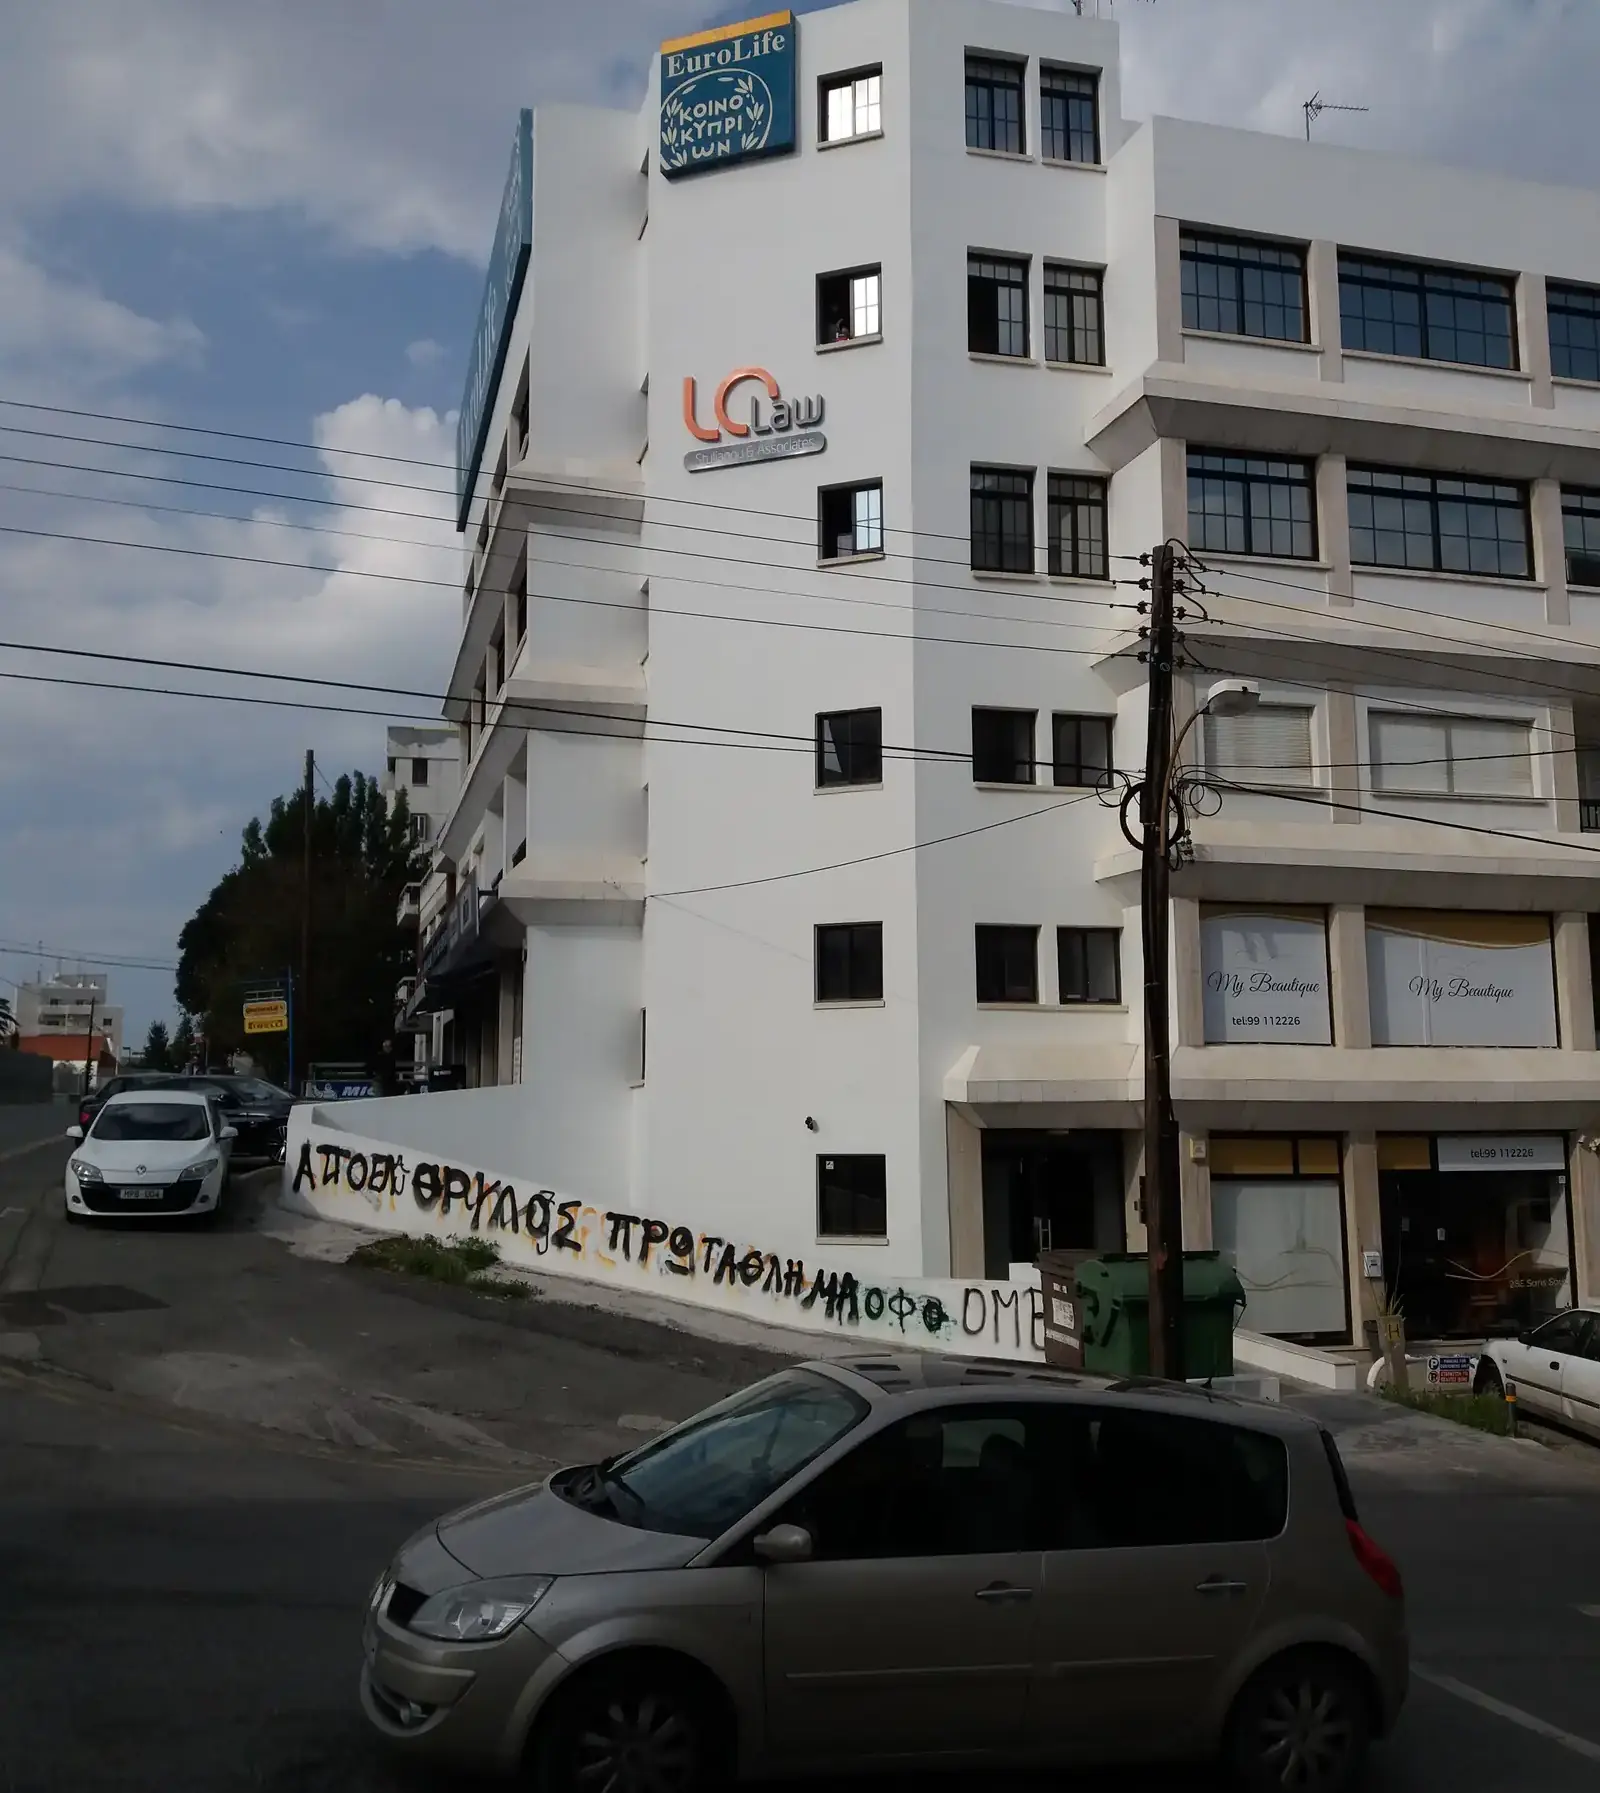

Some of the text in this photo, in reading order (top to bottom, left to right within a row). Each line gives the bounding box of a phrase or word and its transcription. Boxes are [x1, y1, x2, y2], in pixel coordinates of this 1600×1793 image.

[667, 31, 786, 78] EuroLife
[680, 95, 744, 125] ΚΟΙΝΟ
[681, 115, 743, 146] ΚΥΠΡΙ
[695, 449, 744, 465] Stylianou
[757, 437, 815, 456] Associates
[1207, 970, 1320, 997] My Beautique
[1408, 975, 1514, 1003] My Beautique
[1232, 1016, 1301, 1026] tel:99 112226
[1499, 1148, 1534, 1158] 112226
